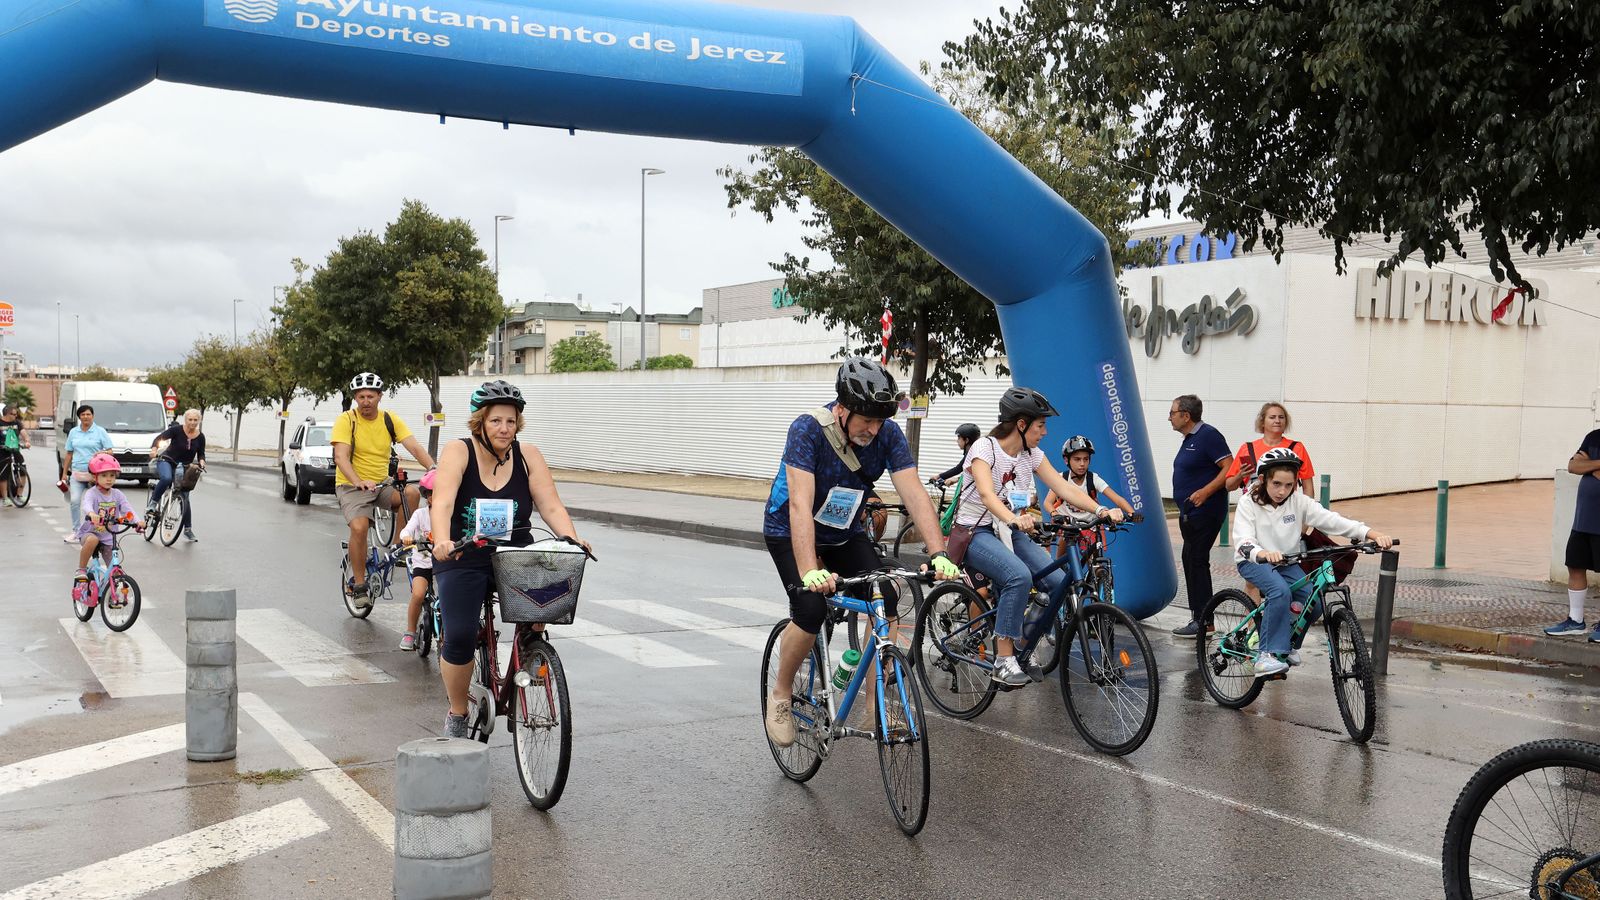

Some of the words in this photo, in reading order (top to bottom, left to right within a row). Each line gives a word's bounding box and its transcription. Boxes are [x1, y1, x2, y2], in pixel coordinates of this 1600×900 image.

[295, 11, 450, 47] Deportes
[628, 32, 676, 53] de
[686, 37, 787, 65] Jerez
[1355, 267, 1549, 327] HIPERCOR
[1102, 363, 1143, 511] deportes@aytojerez.es
